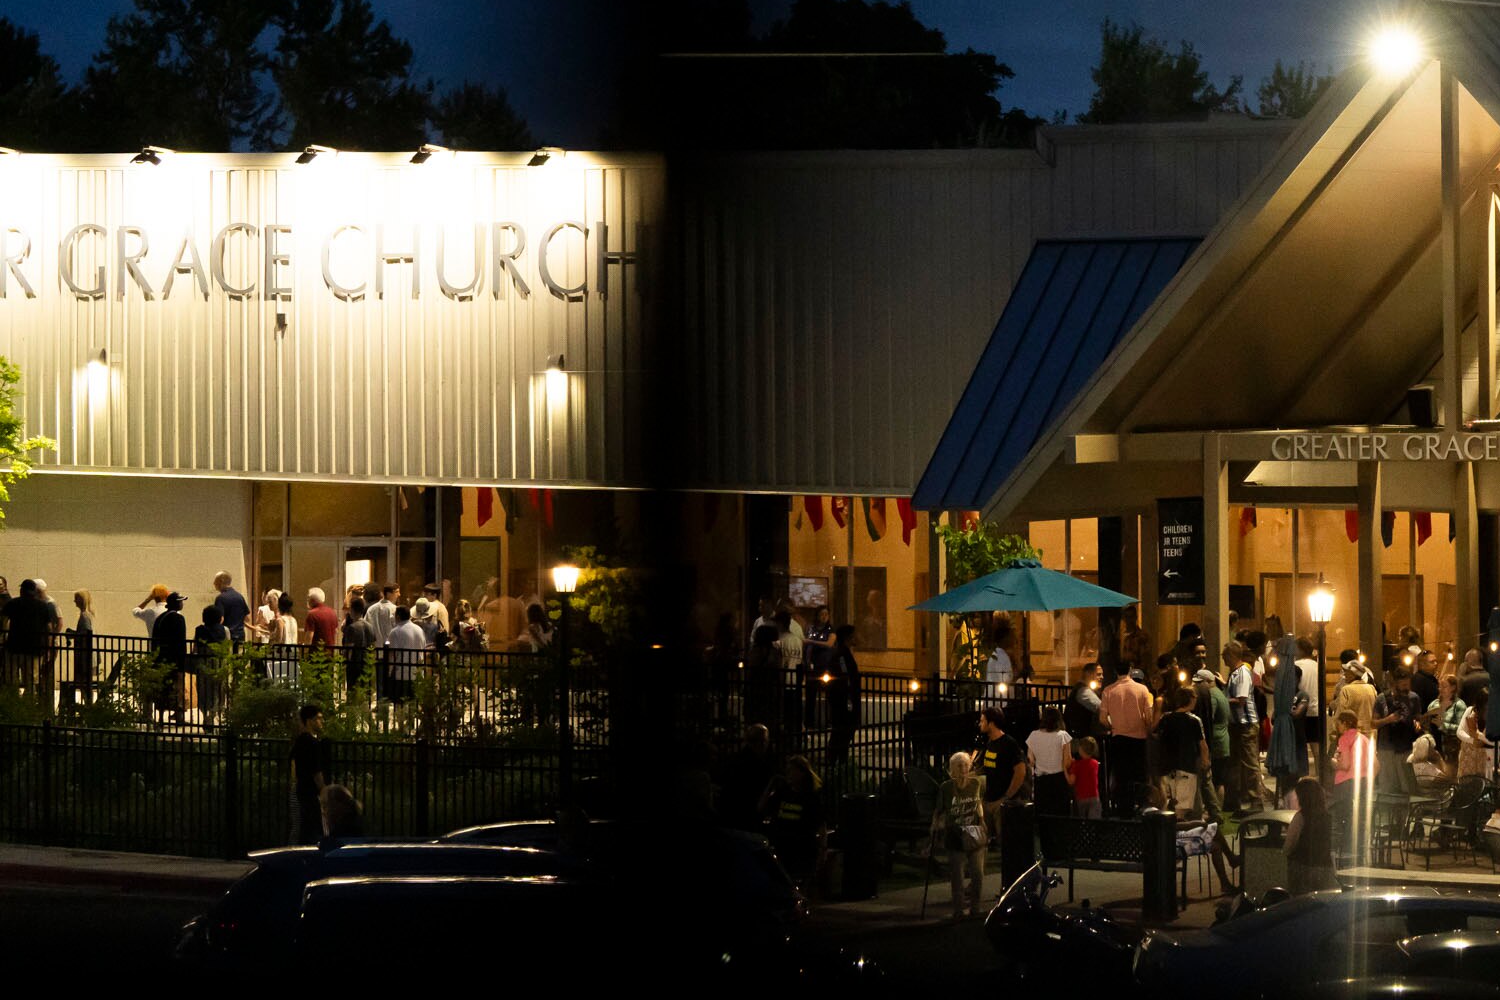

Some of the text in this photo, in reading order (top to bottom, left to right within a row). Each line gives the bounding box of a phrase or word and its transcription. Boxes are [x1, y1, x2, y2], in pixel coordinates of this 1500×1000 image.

[60, 223, 293, 301] GRACE
[320, 221, 645, 301] CHURCH
[1271, 434, 1391, 461] GREATER
[1402, 434, 1498, 461] GRACE
[1163, 525, 1193, 535] CHILDREN
[1164, 537, 1191, 546] JR TEENS
[1163, 548, 1183, 557] TEENS
